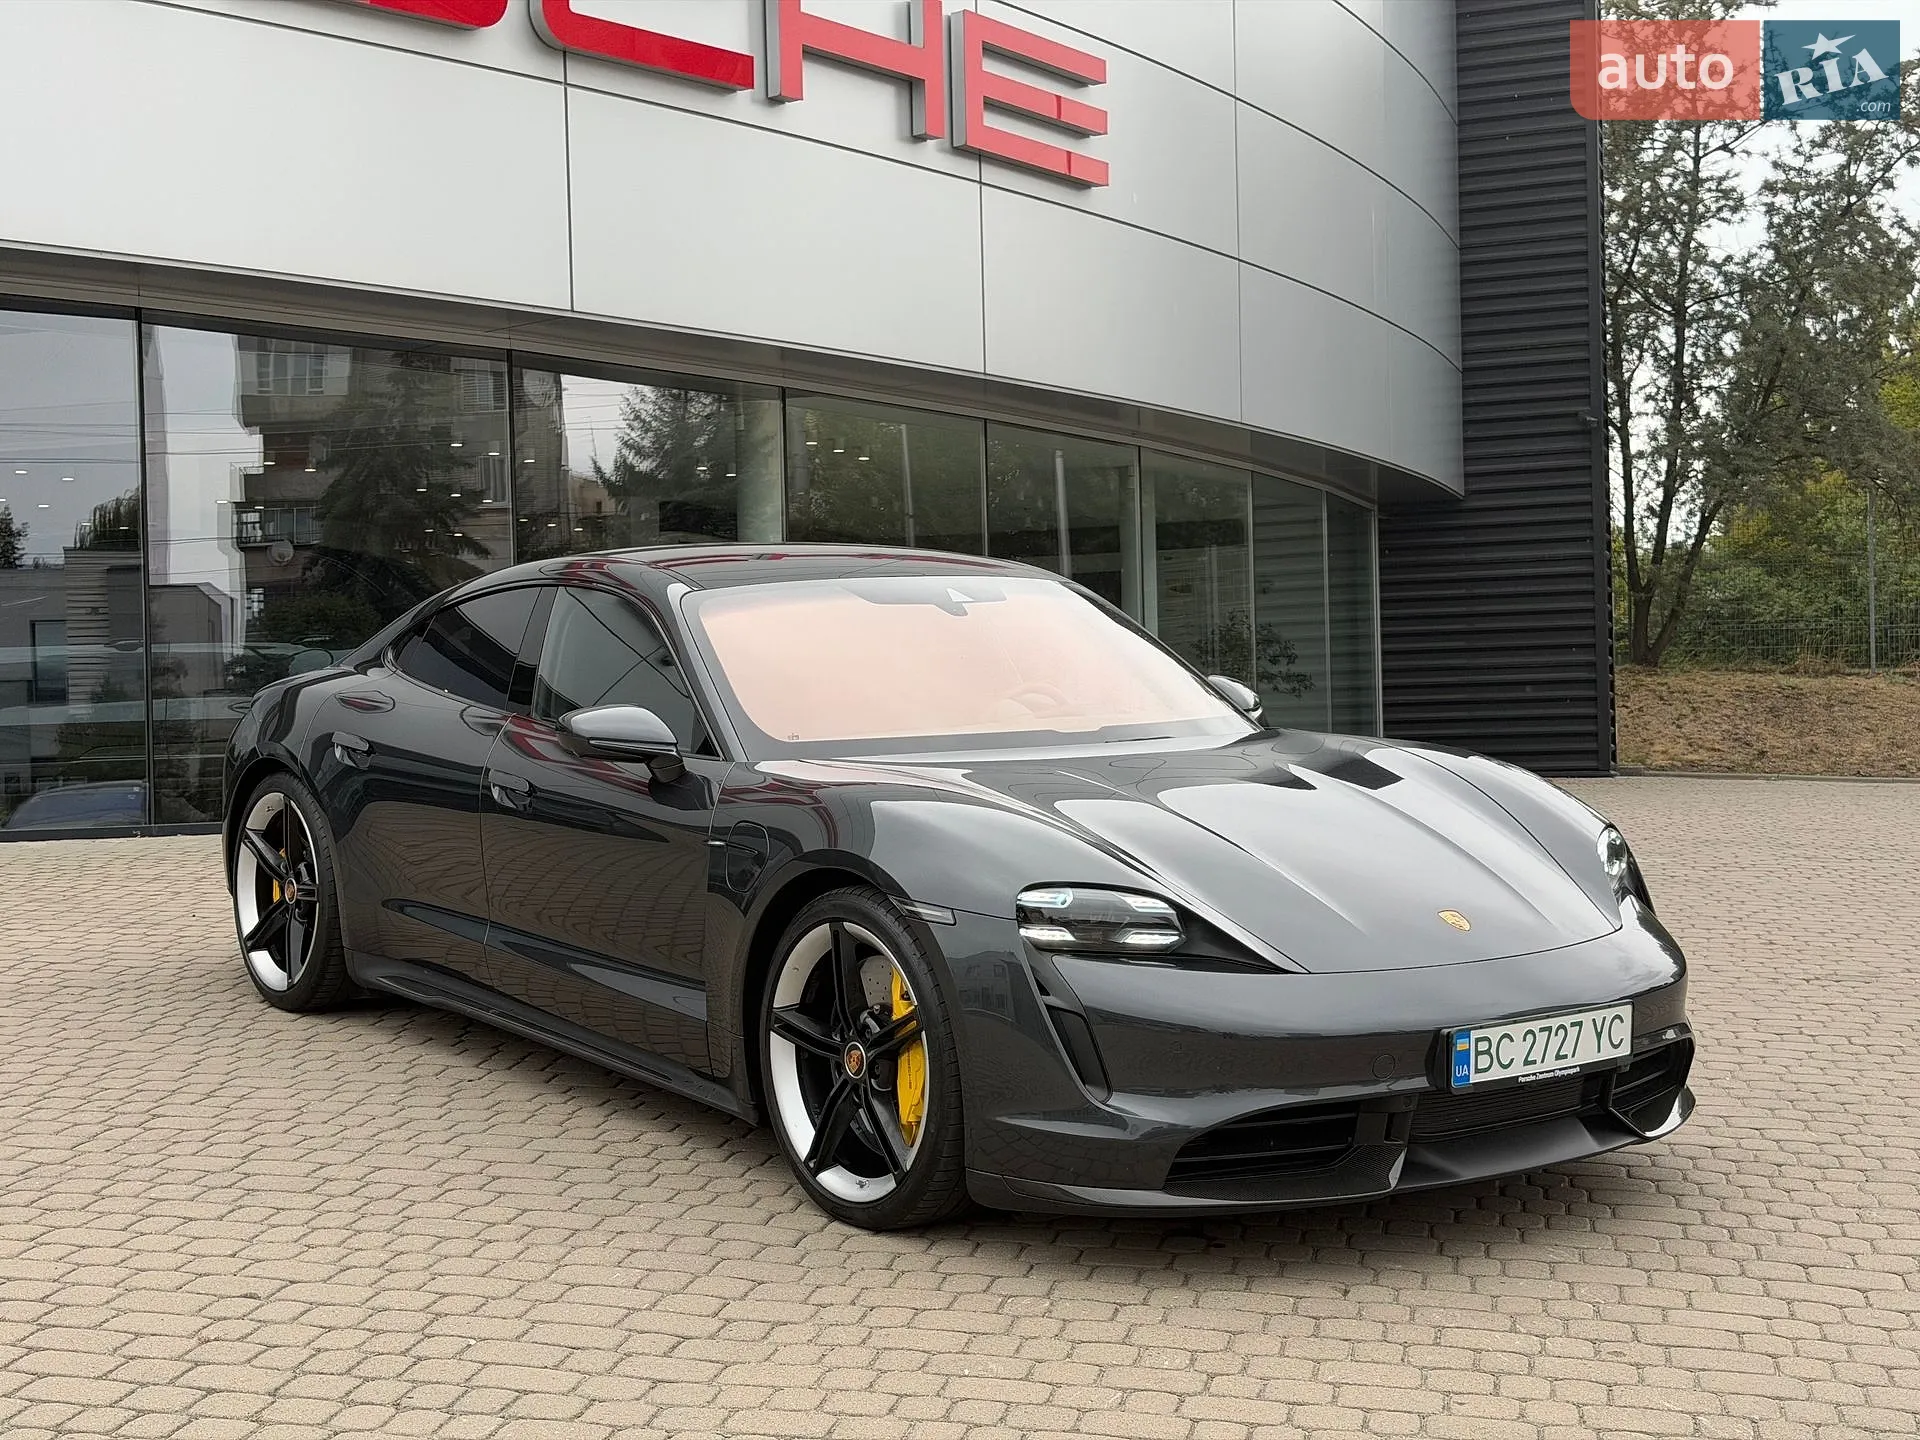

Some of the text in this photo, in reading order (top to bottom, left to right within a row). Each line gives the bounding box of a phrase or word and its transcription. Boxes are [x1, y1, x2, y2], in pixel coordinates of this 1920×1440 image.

[1474, 1013, 1625, 1074] BC 2727 YC
[1455, 1064, 1469, 1077] UA
